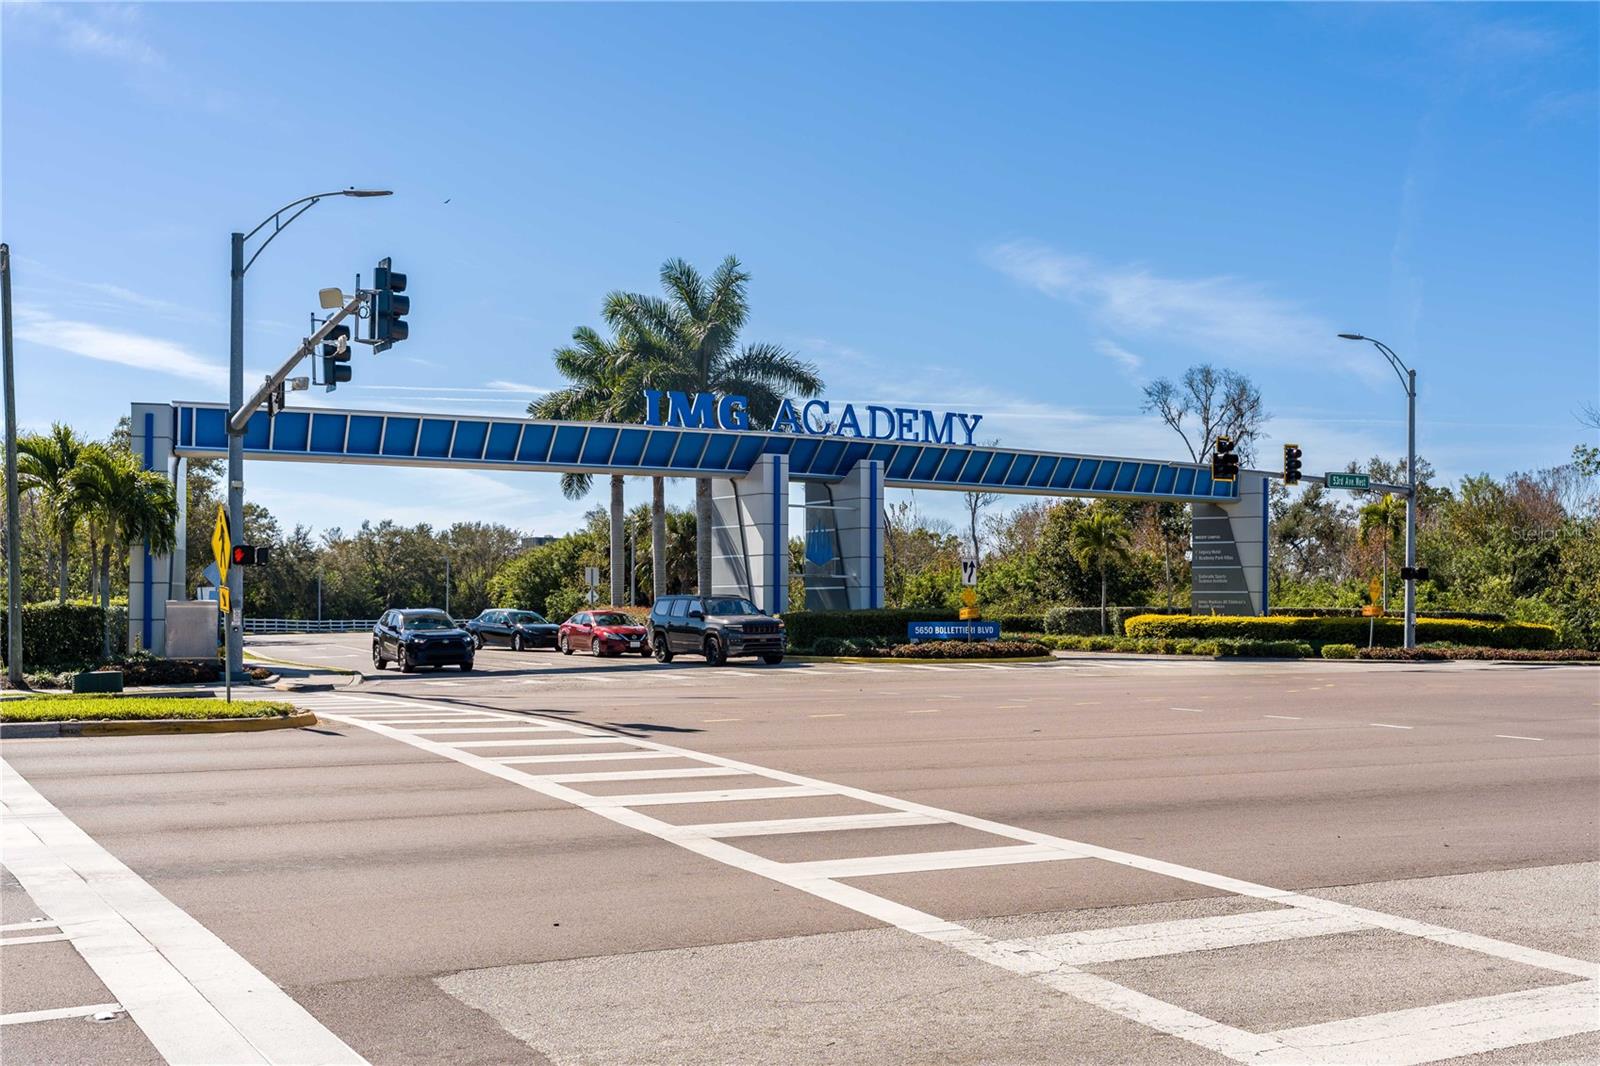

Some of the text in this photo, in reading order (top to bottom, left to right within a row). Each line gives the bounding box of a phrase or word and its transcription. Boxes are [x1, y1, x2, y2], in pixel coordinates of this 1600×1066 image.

[643, 389, 983, 446] IMG ACADEMY
[1333, 475, 1344, 486] 53rd
[1356, 477, 1366, 488] West
[915, 626, 994, 634] 5650 BOLLETTIERI BLVD
